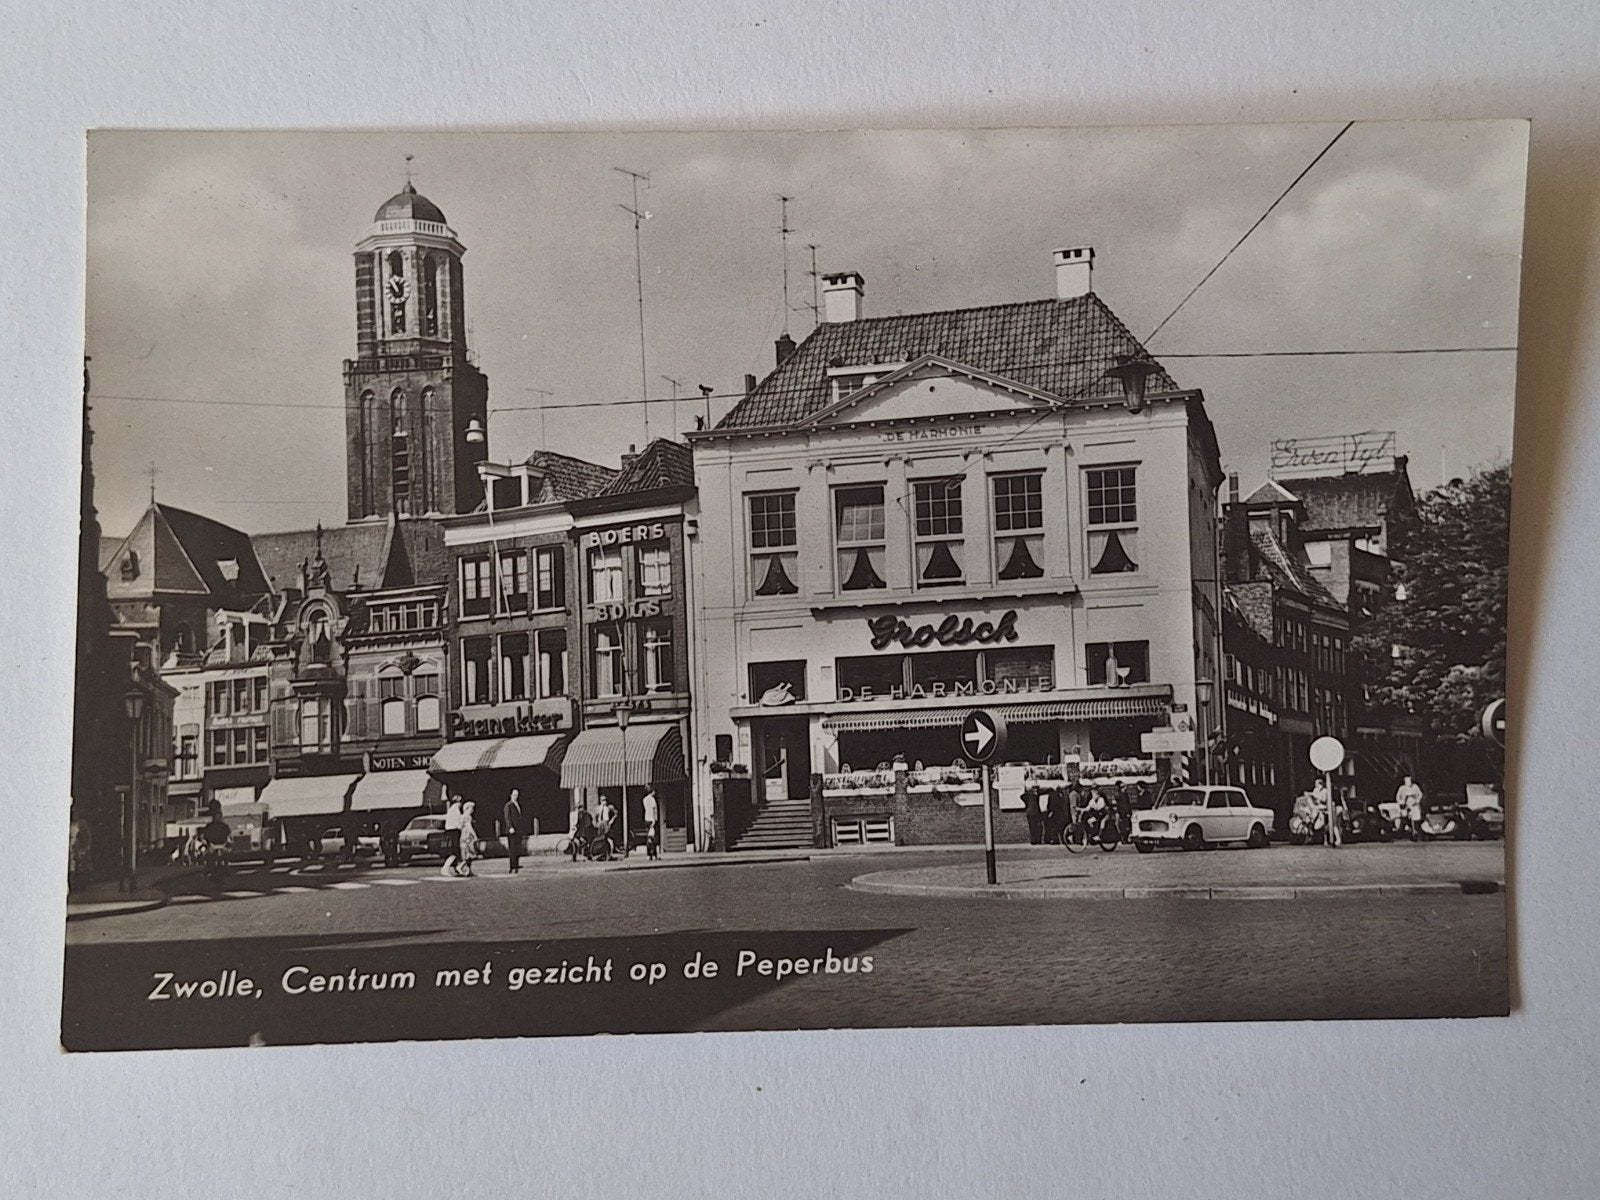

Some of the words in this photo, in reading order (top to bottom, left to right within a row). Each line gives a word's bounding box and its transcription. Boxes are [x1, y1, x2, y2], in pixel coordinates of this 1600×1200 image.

[589, 523, 664, 547] BOERS
[597, 600, 660, 621] BOLS
[867, 610, 1018, 651] Grolsch
[841, 686, 874, 702] DE
[891, 676, 1052, 700] HARMONIE
[448, 704, 564, 737] Paanakker
[373, 758, 406, 769] NOTEN
[412, 756, 432, 767] SHO
